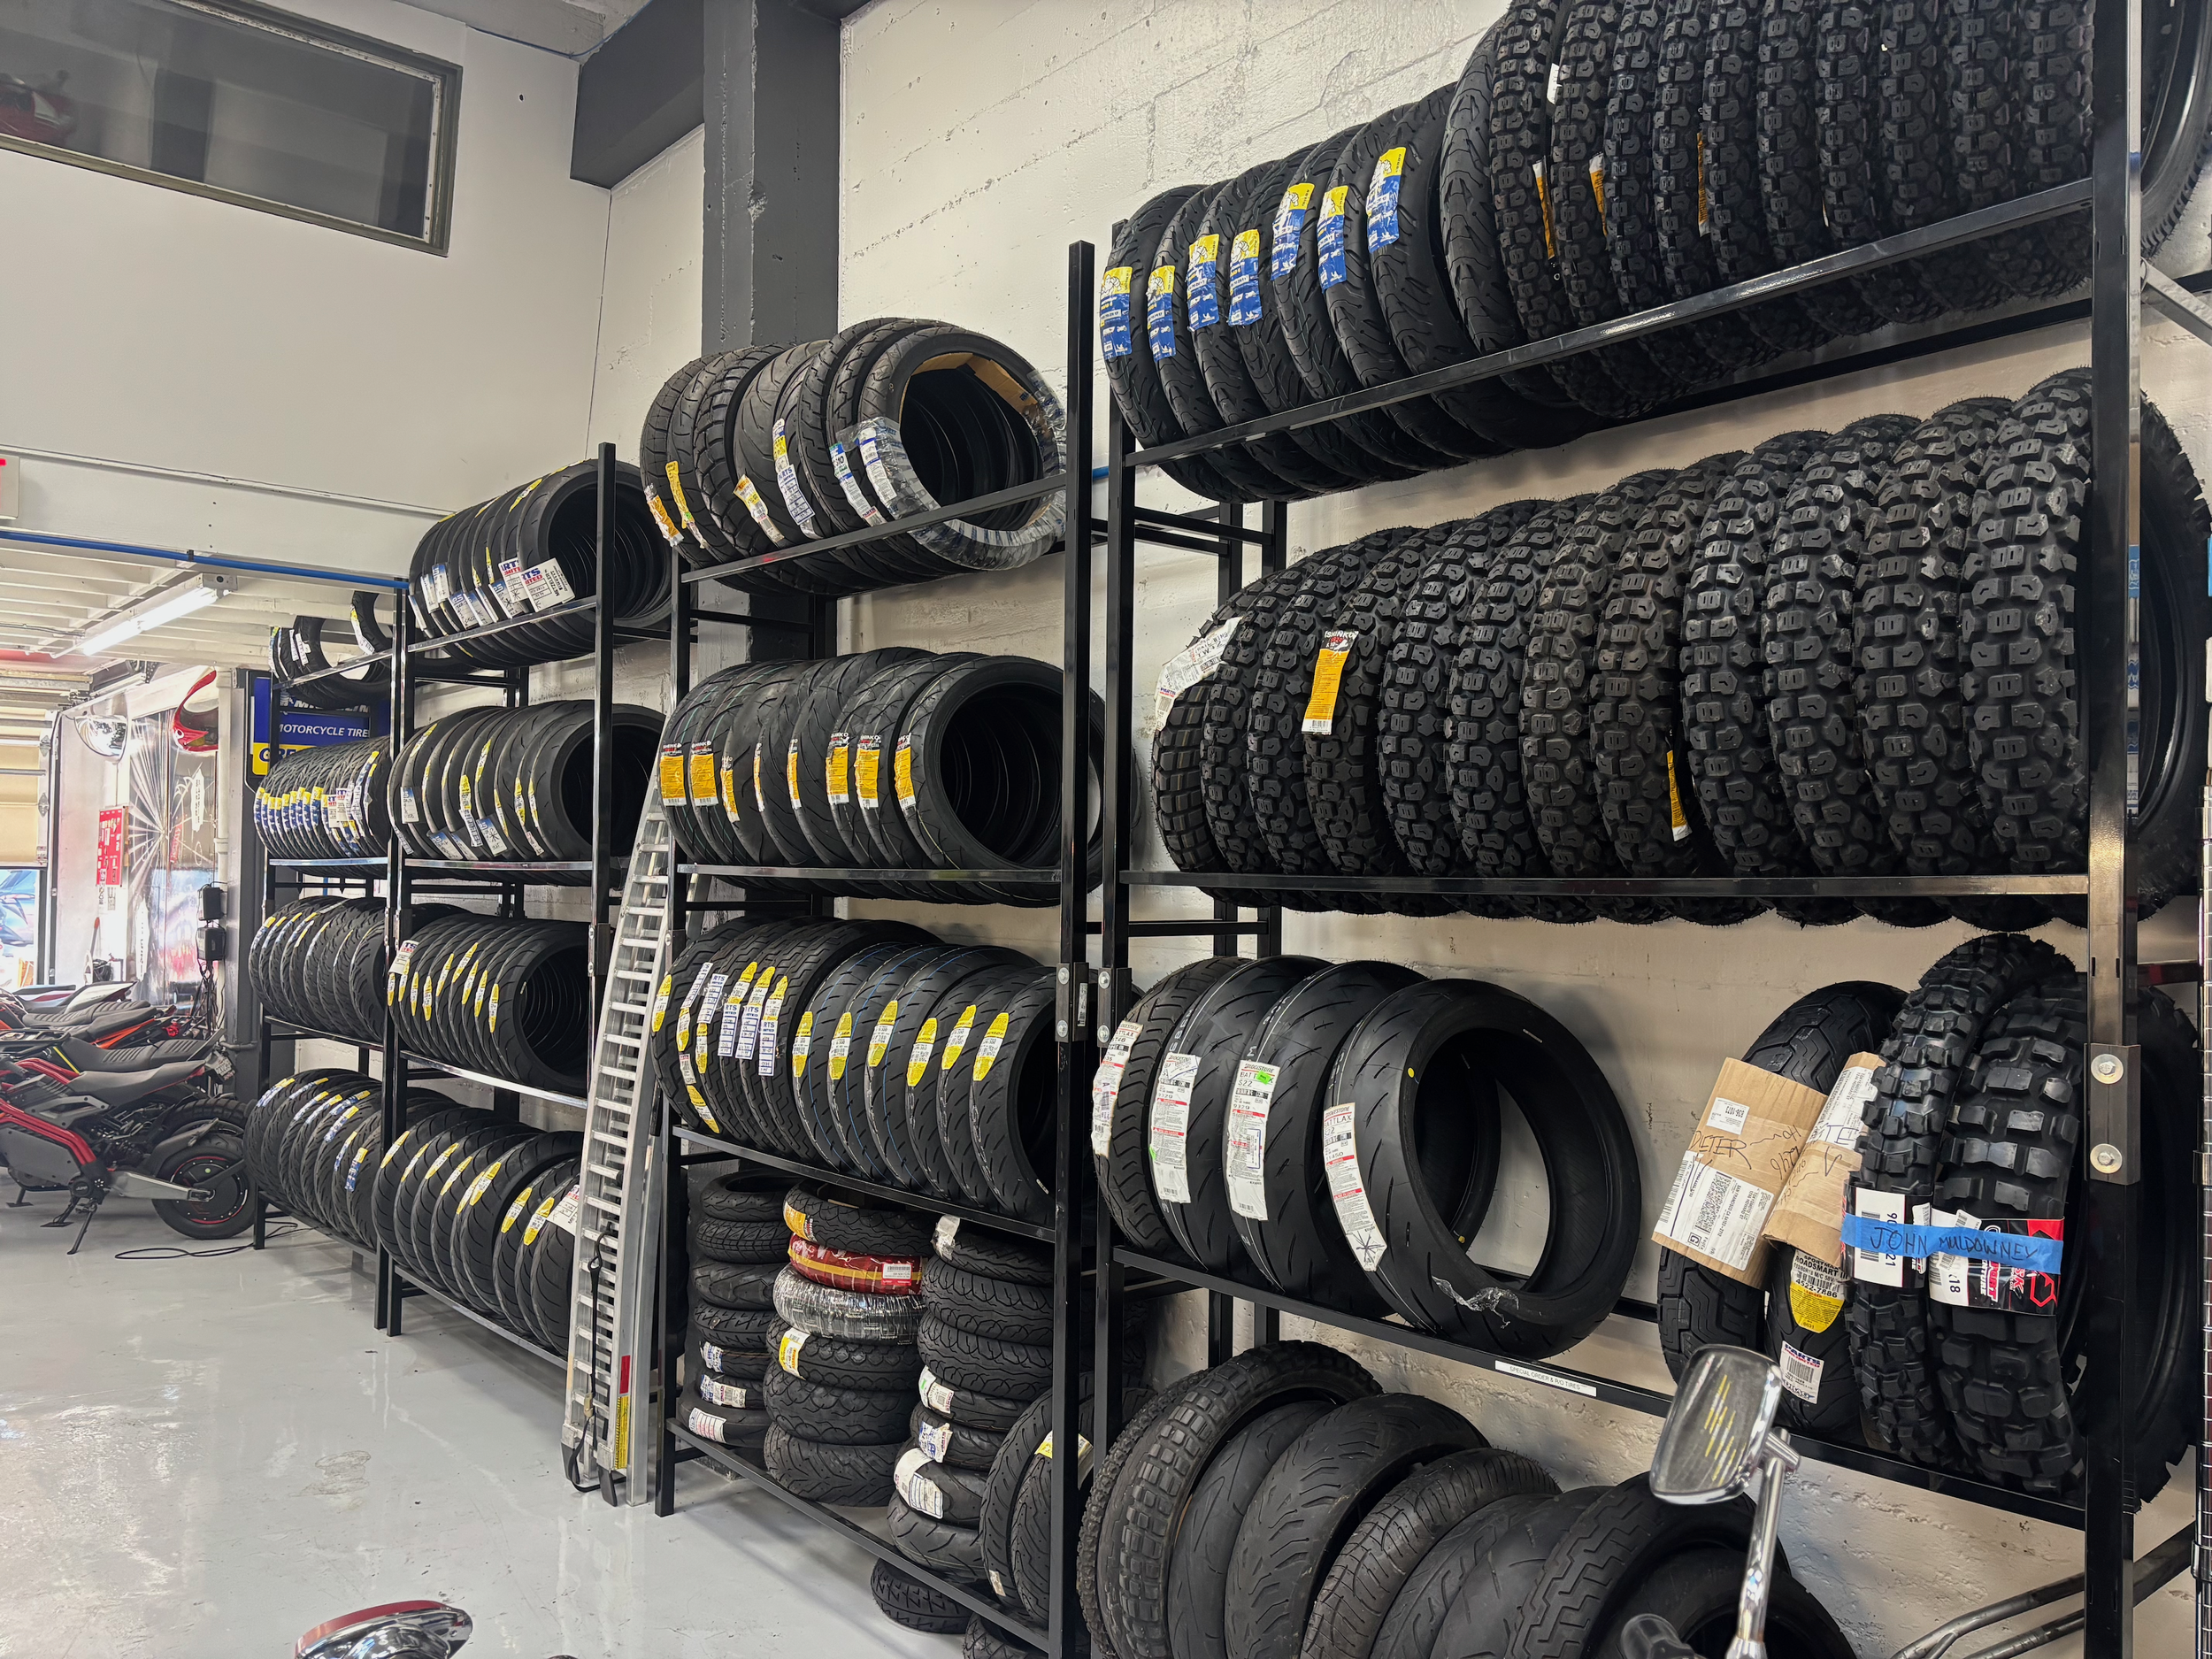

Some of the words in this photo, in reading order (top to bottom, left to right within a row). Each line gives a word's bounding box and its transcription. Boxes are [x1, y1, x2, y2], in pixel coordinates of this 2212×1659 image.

[1688, 1130, 1752, 1170] DIETER
[1870, 1226, 1928, 1256] JOHN
[1939, 1235, 2039, 1261] MULDOWNEY
[1795, 1256, 1839, 1276] ROADSMART
[1796, 1279, 1838, 1298] 4522-7886
[1785, 1344, 1821, 1364] PARTS
[1510, 1366, 1530, 1376] SPECIAL
[1532, 1371, 1549, 1382] ORDER
[1565, 1381, 1581, 1390] TIRES
